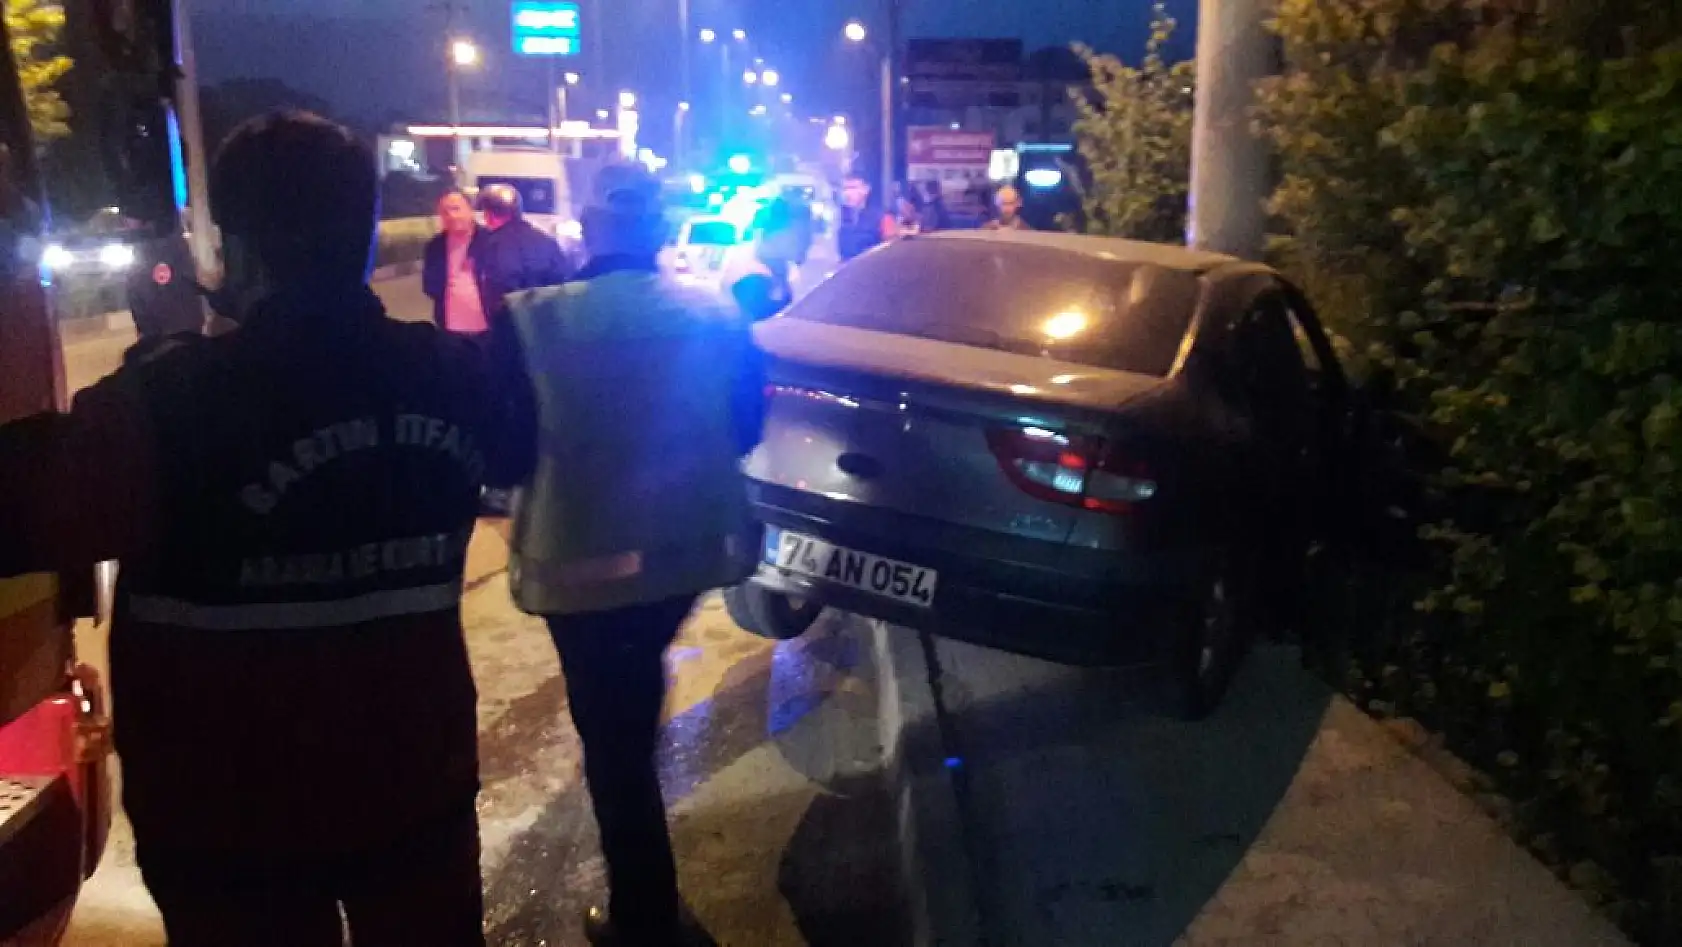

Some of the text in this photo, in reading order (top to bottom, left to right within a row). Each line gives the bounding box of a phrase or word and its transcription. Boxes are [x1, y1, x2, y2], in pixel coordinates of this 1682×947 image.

[784, 535, 931, 602] 74 AN 054
